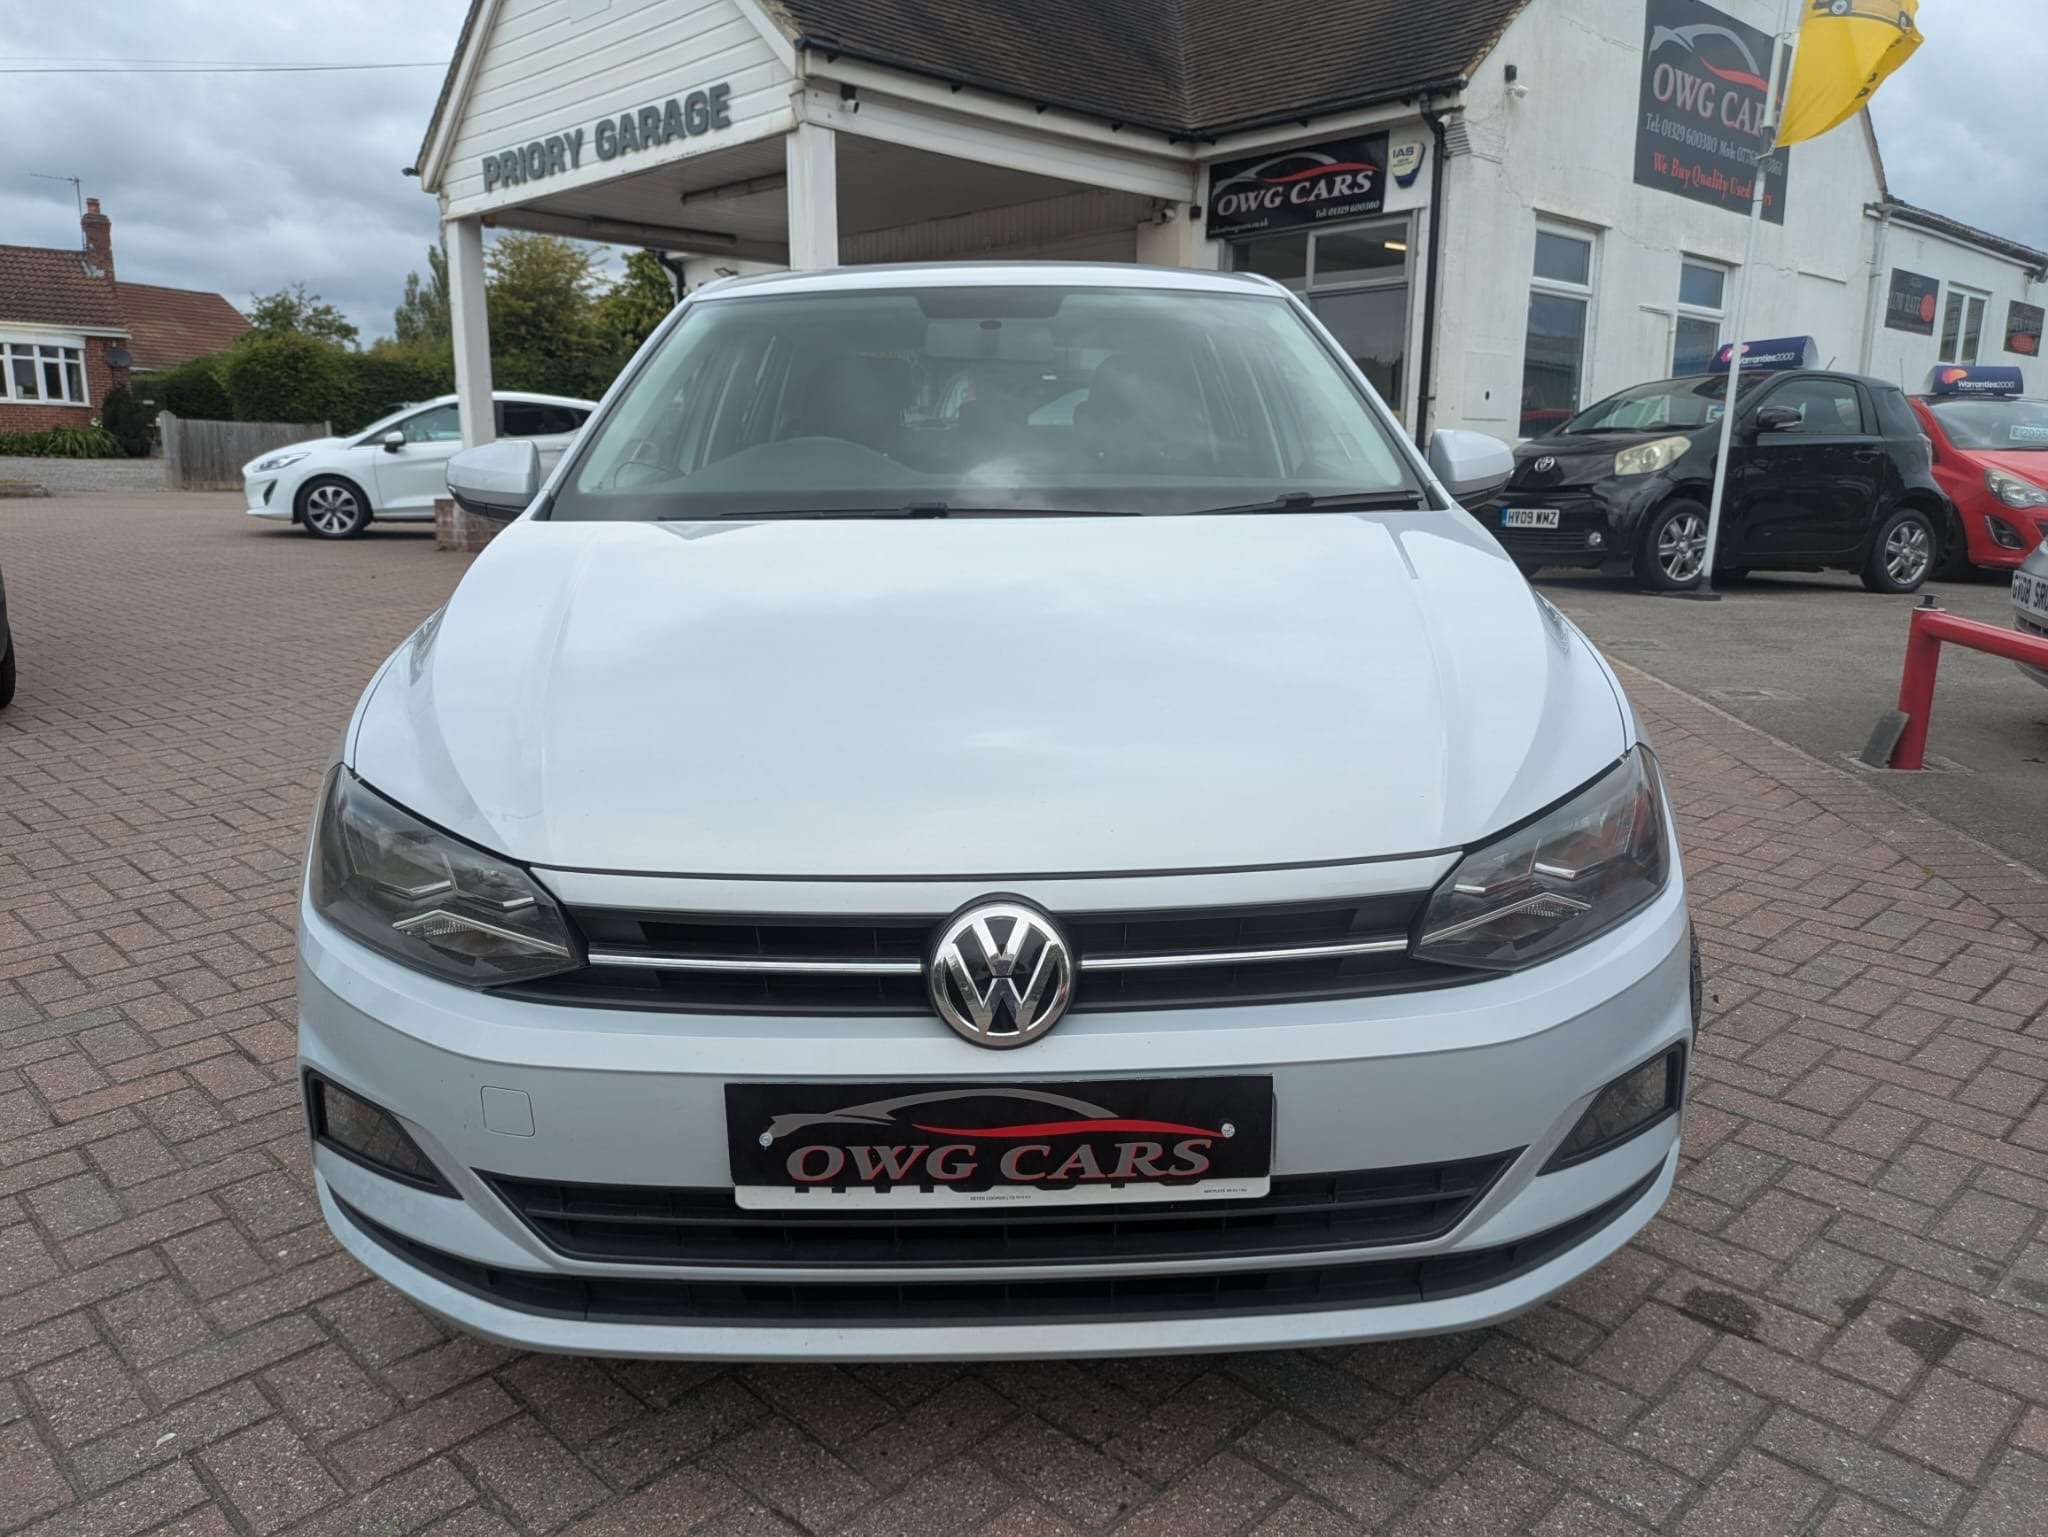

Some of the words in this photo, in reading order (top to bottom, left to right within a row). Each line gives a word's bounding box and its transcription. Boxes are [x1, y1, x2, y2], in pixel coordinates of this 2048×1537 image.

[1653, 63, 1716, 118] OWG
[482, 127, 584, 193] PRIORY
[594, 82, 732, 162] GARAGE
[1392, 146, 1414, 158] IAS
[1217, 186, 1285, 216] OWG
[1290, 169, 1374, 204] CARS
[1654, 151, 1668, 174] We
[1672, 157, 1691, 189] Buy
[1692, 163, 1729, 200] Quality
[1730, 176, 1752, 199] Used
[1536, 511, 1557, 526] WMZ
[786, 1144, 980, 1182] OWG
[1000, 1138, 1213, 1181] CARS
